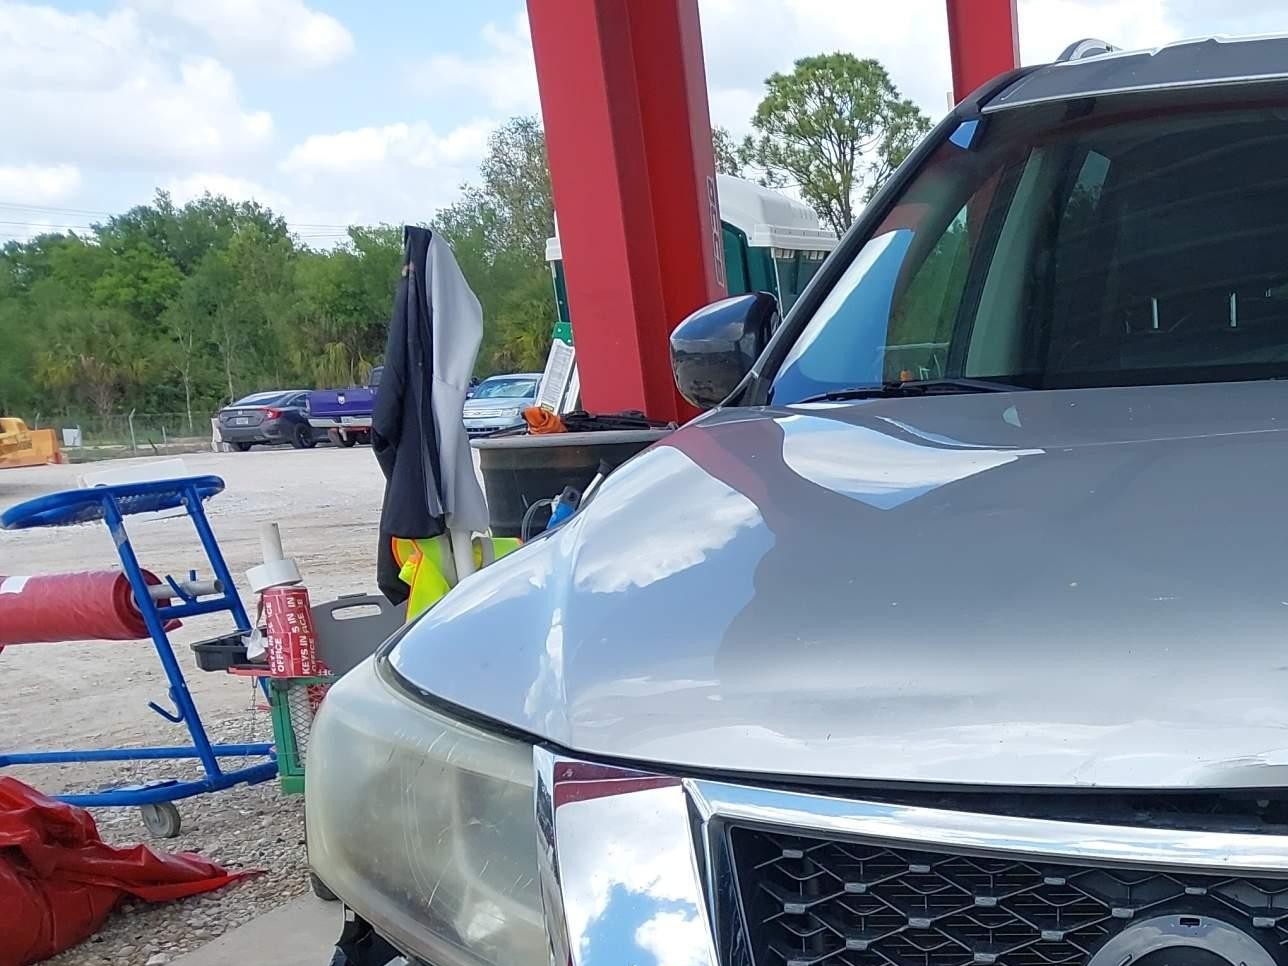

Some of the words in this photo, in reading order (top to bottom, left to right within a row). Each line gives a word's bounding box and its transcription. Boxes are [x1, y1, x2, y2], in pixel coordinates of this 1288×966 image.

[299, 635, 308, 646] IN
[275, 638, 285, 672] OFFICE
[301, 649, 310, 674] KEYS
